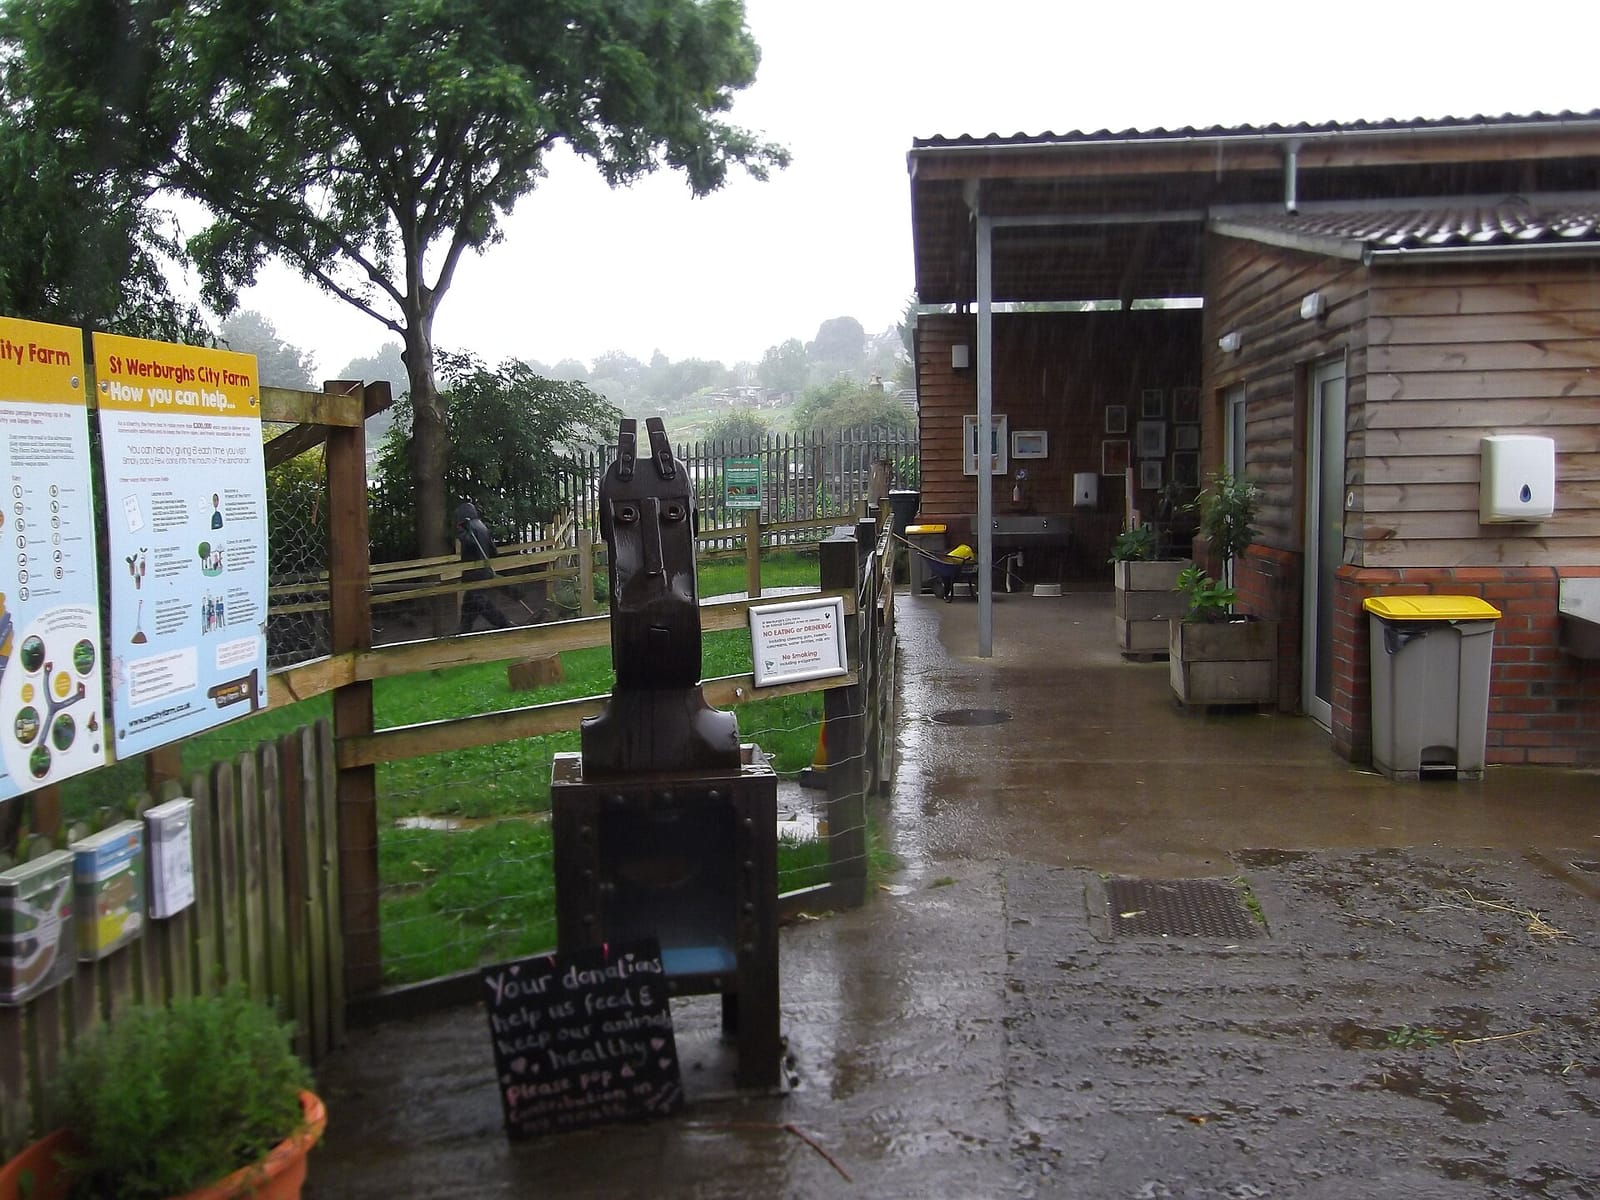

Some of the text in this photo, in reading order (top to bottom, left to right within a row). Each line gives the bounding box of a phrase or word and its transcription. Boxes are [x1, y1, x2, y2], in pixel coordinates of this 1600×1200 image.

[28, 343, 71, 367] Farm
[109, 354, 250, 388] St Werburghs City Farm
[109, 380, 236, 412] How you can help...
[763, 630, 773, 638] NO
[774, 627, 795, 636] EATING
[804, 622, 832, 632] DRINKING
[792, 650, 818, 660] Smoking
[485, 957, 662, 1006] Your donations
[492, 1006, 541, 1034] help
[549, 1001, 576, 1019] us
[584, 988, 632, 1016] feed
[497, 1031, 549, 1056] keep
[557, 1023, 591, 1041] our
[548, 1038, 648, 1069] healthy
